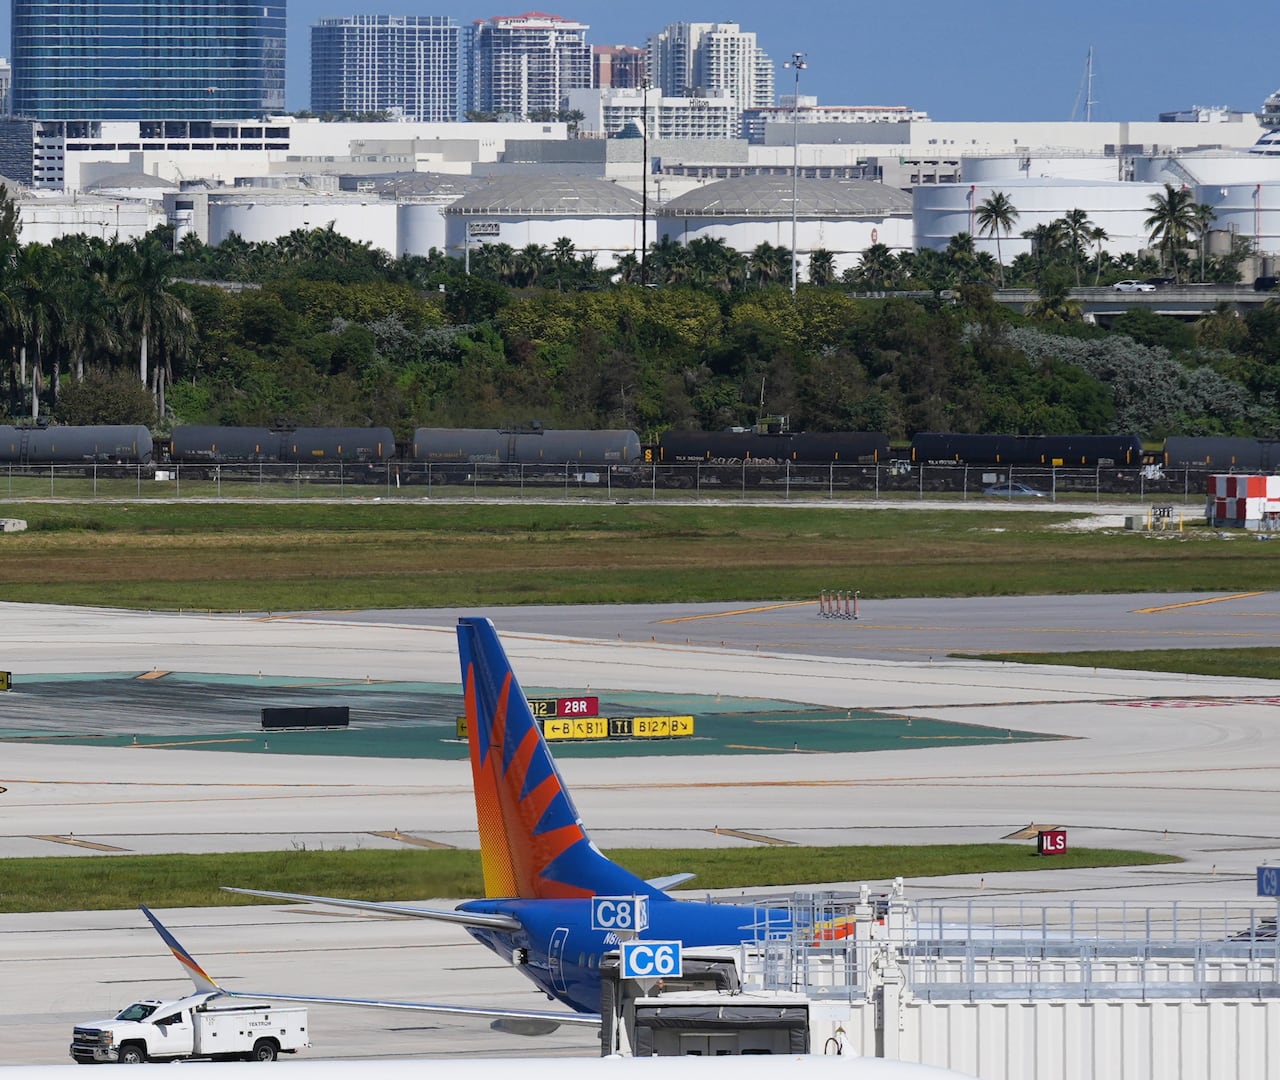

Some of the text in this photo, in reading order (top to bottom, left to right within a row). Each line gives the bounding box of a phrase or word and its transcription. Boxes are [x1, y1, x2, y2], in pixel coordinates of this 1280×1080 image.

[564, 700, 588, 713] 28R
[562, 722, 570, 734] B
[586, 722, 603, 734] B11
[639, 721, 659, 732] B12
[671, 720, 679, 731] B
[1043, 834, 1065, 850] ILS
[1263, 869, 1277, 896] C9
[597, 901, 631, 928] C8
[629, 945, 675, 975] C6
